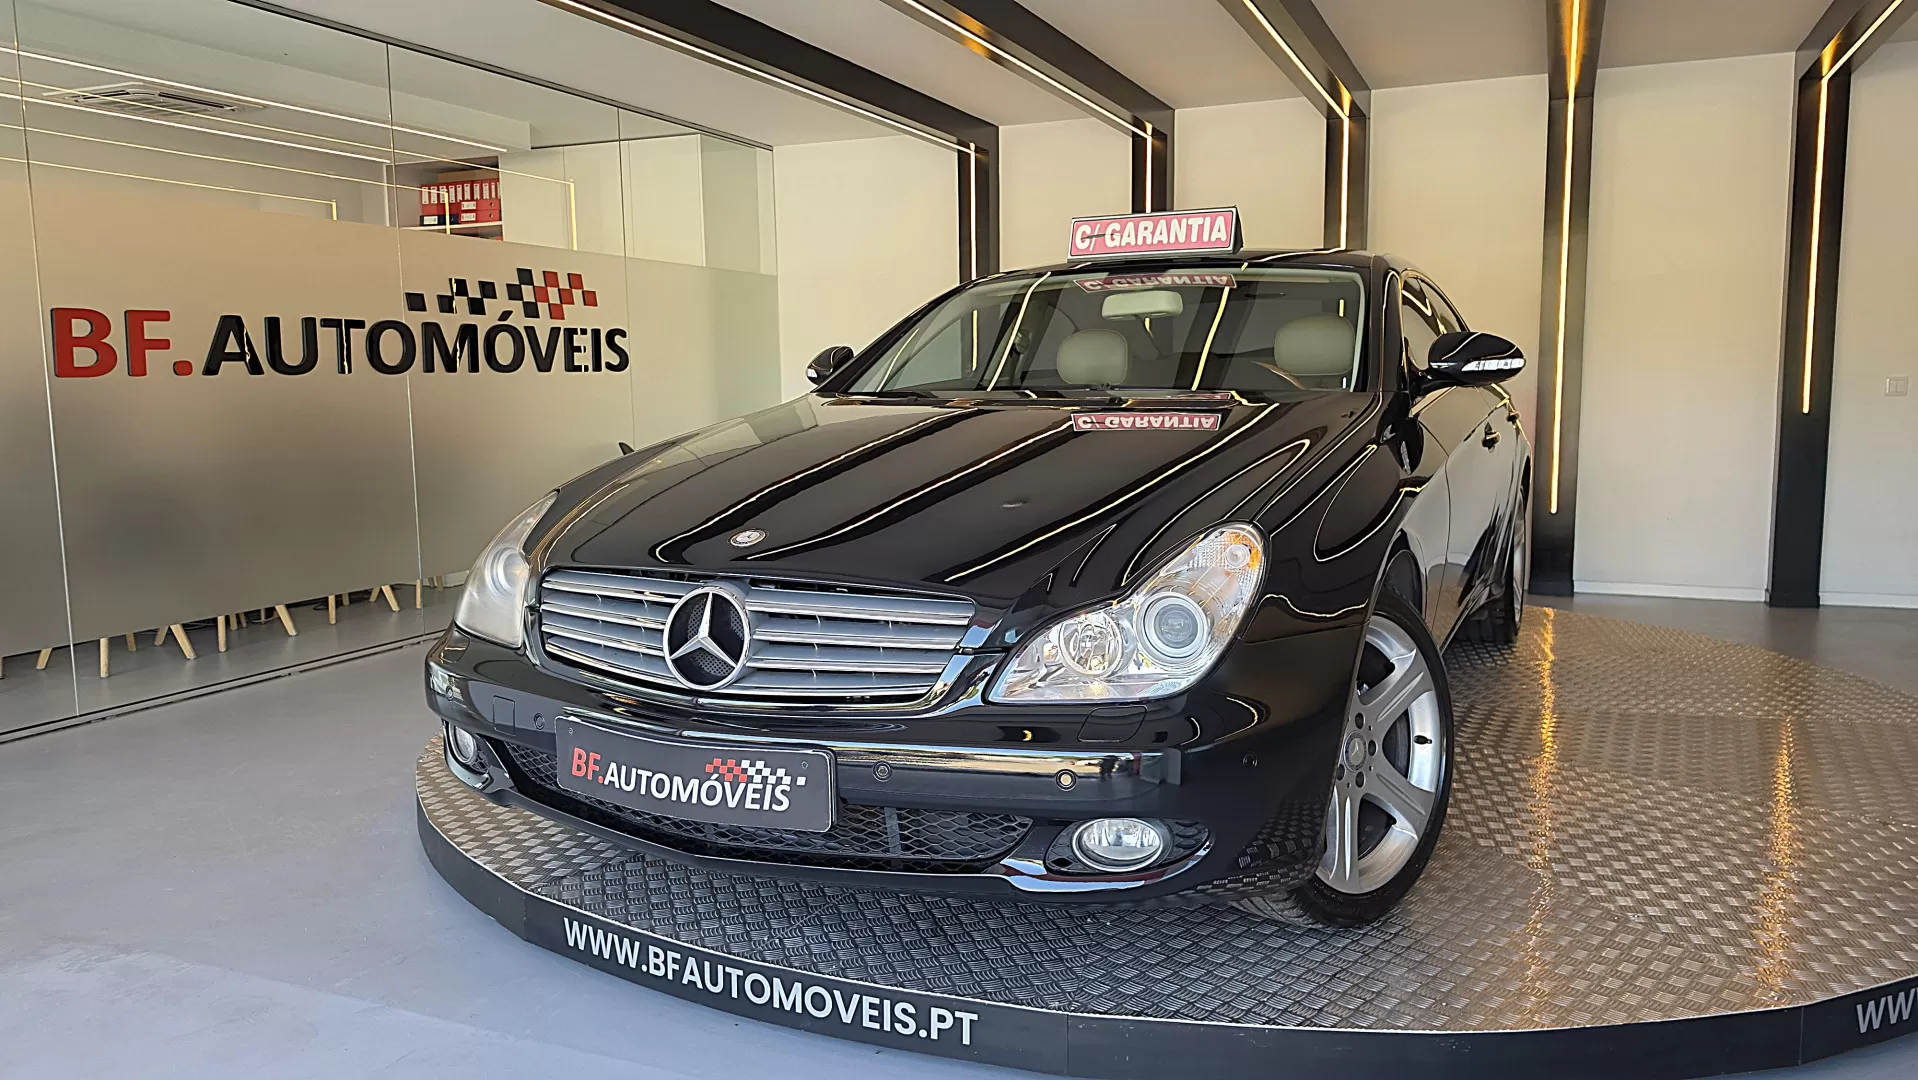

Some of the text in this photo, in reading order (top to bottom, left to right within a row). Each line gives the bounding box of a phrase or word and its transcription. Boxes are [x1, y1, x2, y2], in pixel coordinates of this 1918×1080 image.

[1105, 216, 1227, 247] GARANTIA
[51, 307, 630, 378] BF.AUTOMÓVEIS
[571, 747, 791, 812] BF.AUTOMÓVEIS
[563, 917, 979, 1045] WWW.BFAUTOMOVEIS.PT
[1856, 986, 1918, 1034] WW
